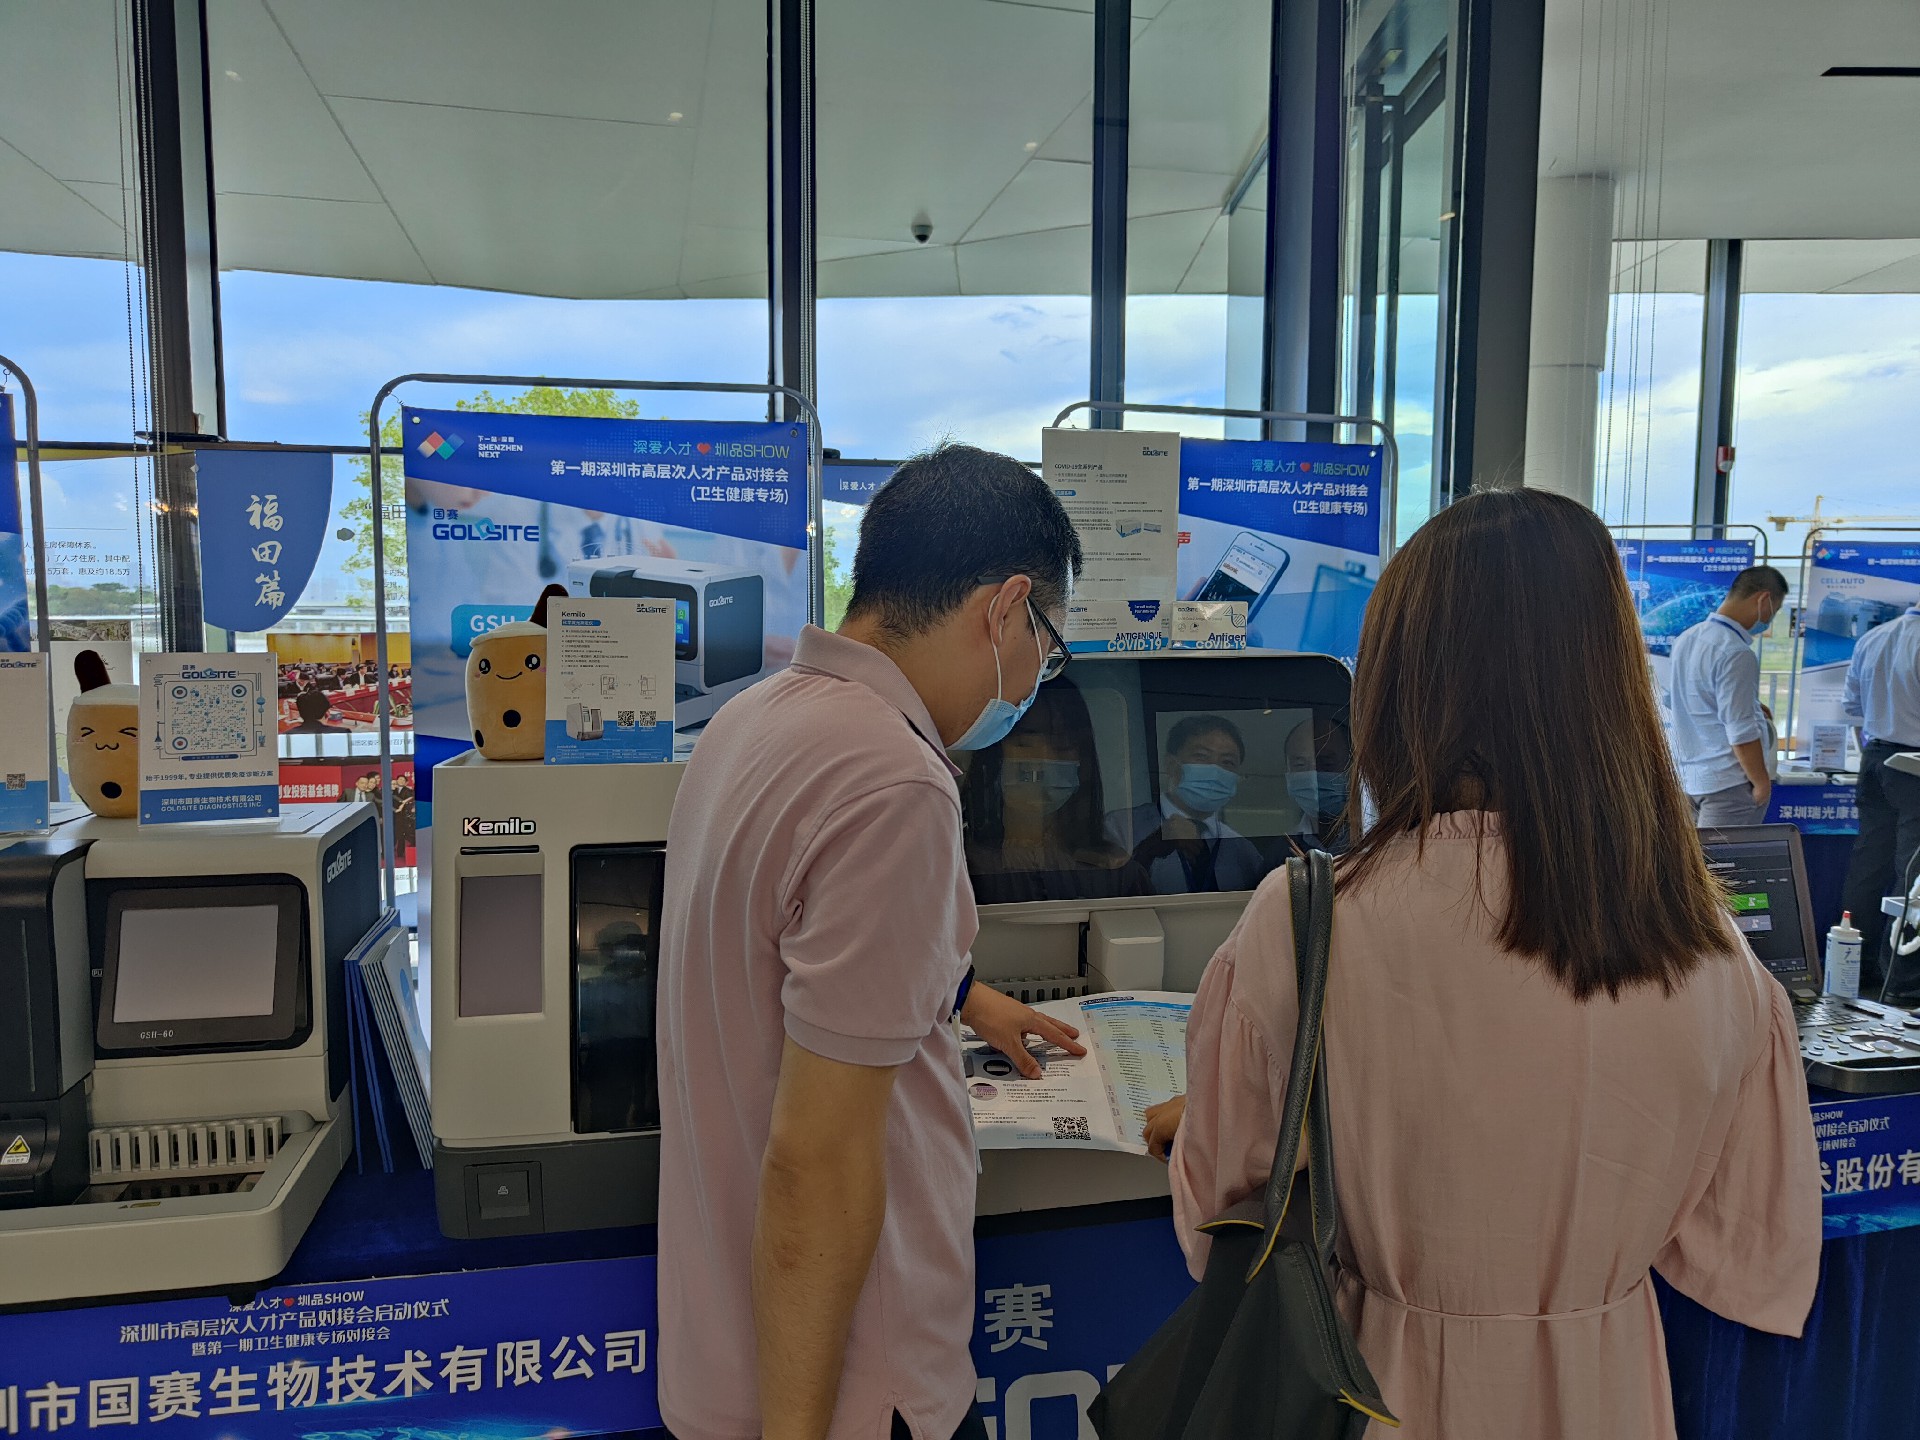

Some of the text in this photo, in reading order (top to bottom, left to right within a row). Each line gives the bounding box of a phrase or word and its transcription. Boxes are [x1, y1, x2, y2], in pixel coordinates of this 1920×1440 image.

[478, 443, 523, 451] SHENZHEN
[633, 440, 789, 459] 深爱人才 圳品SHOW
[550, 459, 789, 483] 第一期深圳市高层次人才产品对接会
[1252, 459, 1370, 477] 深爱人才 圳品SHOW
[690, 485, 789, 505] (卫生健康专场)
[1187, 476, 1369, 498] 第一期深圳市高层次人才产品对接会
[433, 509, 459, 520] 国赛
[1293, 500, 1369, 517] (卫生健康专场)
[432, 518, 540, 541] GOLDSITE
[246, 494, 286, 610] 福田篇
[1821, 577, 1865, 585] CELLAUTO
[1115, 632, 1162, 641] ANTIGENIQUE
[1195, 639, 1247, 650] COVID-19
[1208, 633, 1247, 642] Antigen
[1107, 639, 1162, 652] COVID-19
[182, 668, 236, 679] GOLDSITE
[161, 803, 197, 811] GOLDSITE
[200, 800, 248, 809] DIAGNOSTICS
[463, 819, 535, 834] Kemilo
[140, 1029, 174, 1039] GSH-60
[1815, 1116, 1890, 1138] 对接会启动仪式
[229, 1291, 365, 1313] 深爱人才 圳品SHOW
[120, 1298, 450, 1344] 深圳市高层次人才产品对接会启动仪式
[984, 1283, 1054, 1353] 赛
[191, 1326, 391, 1357] 暨第一期卫生健康专场对接会
